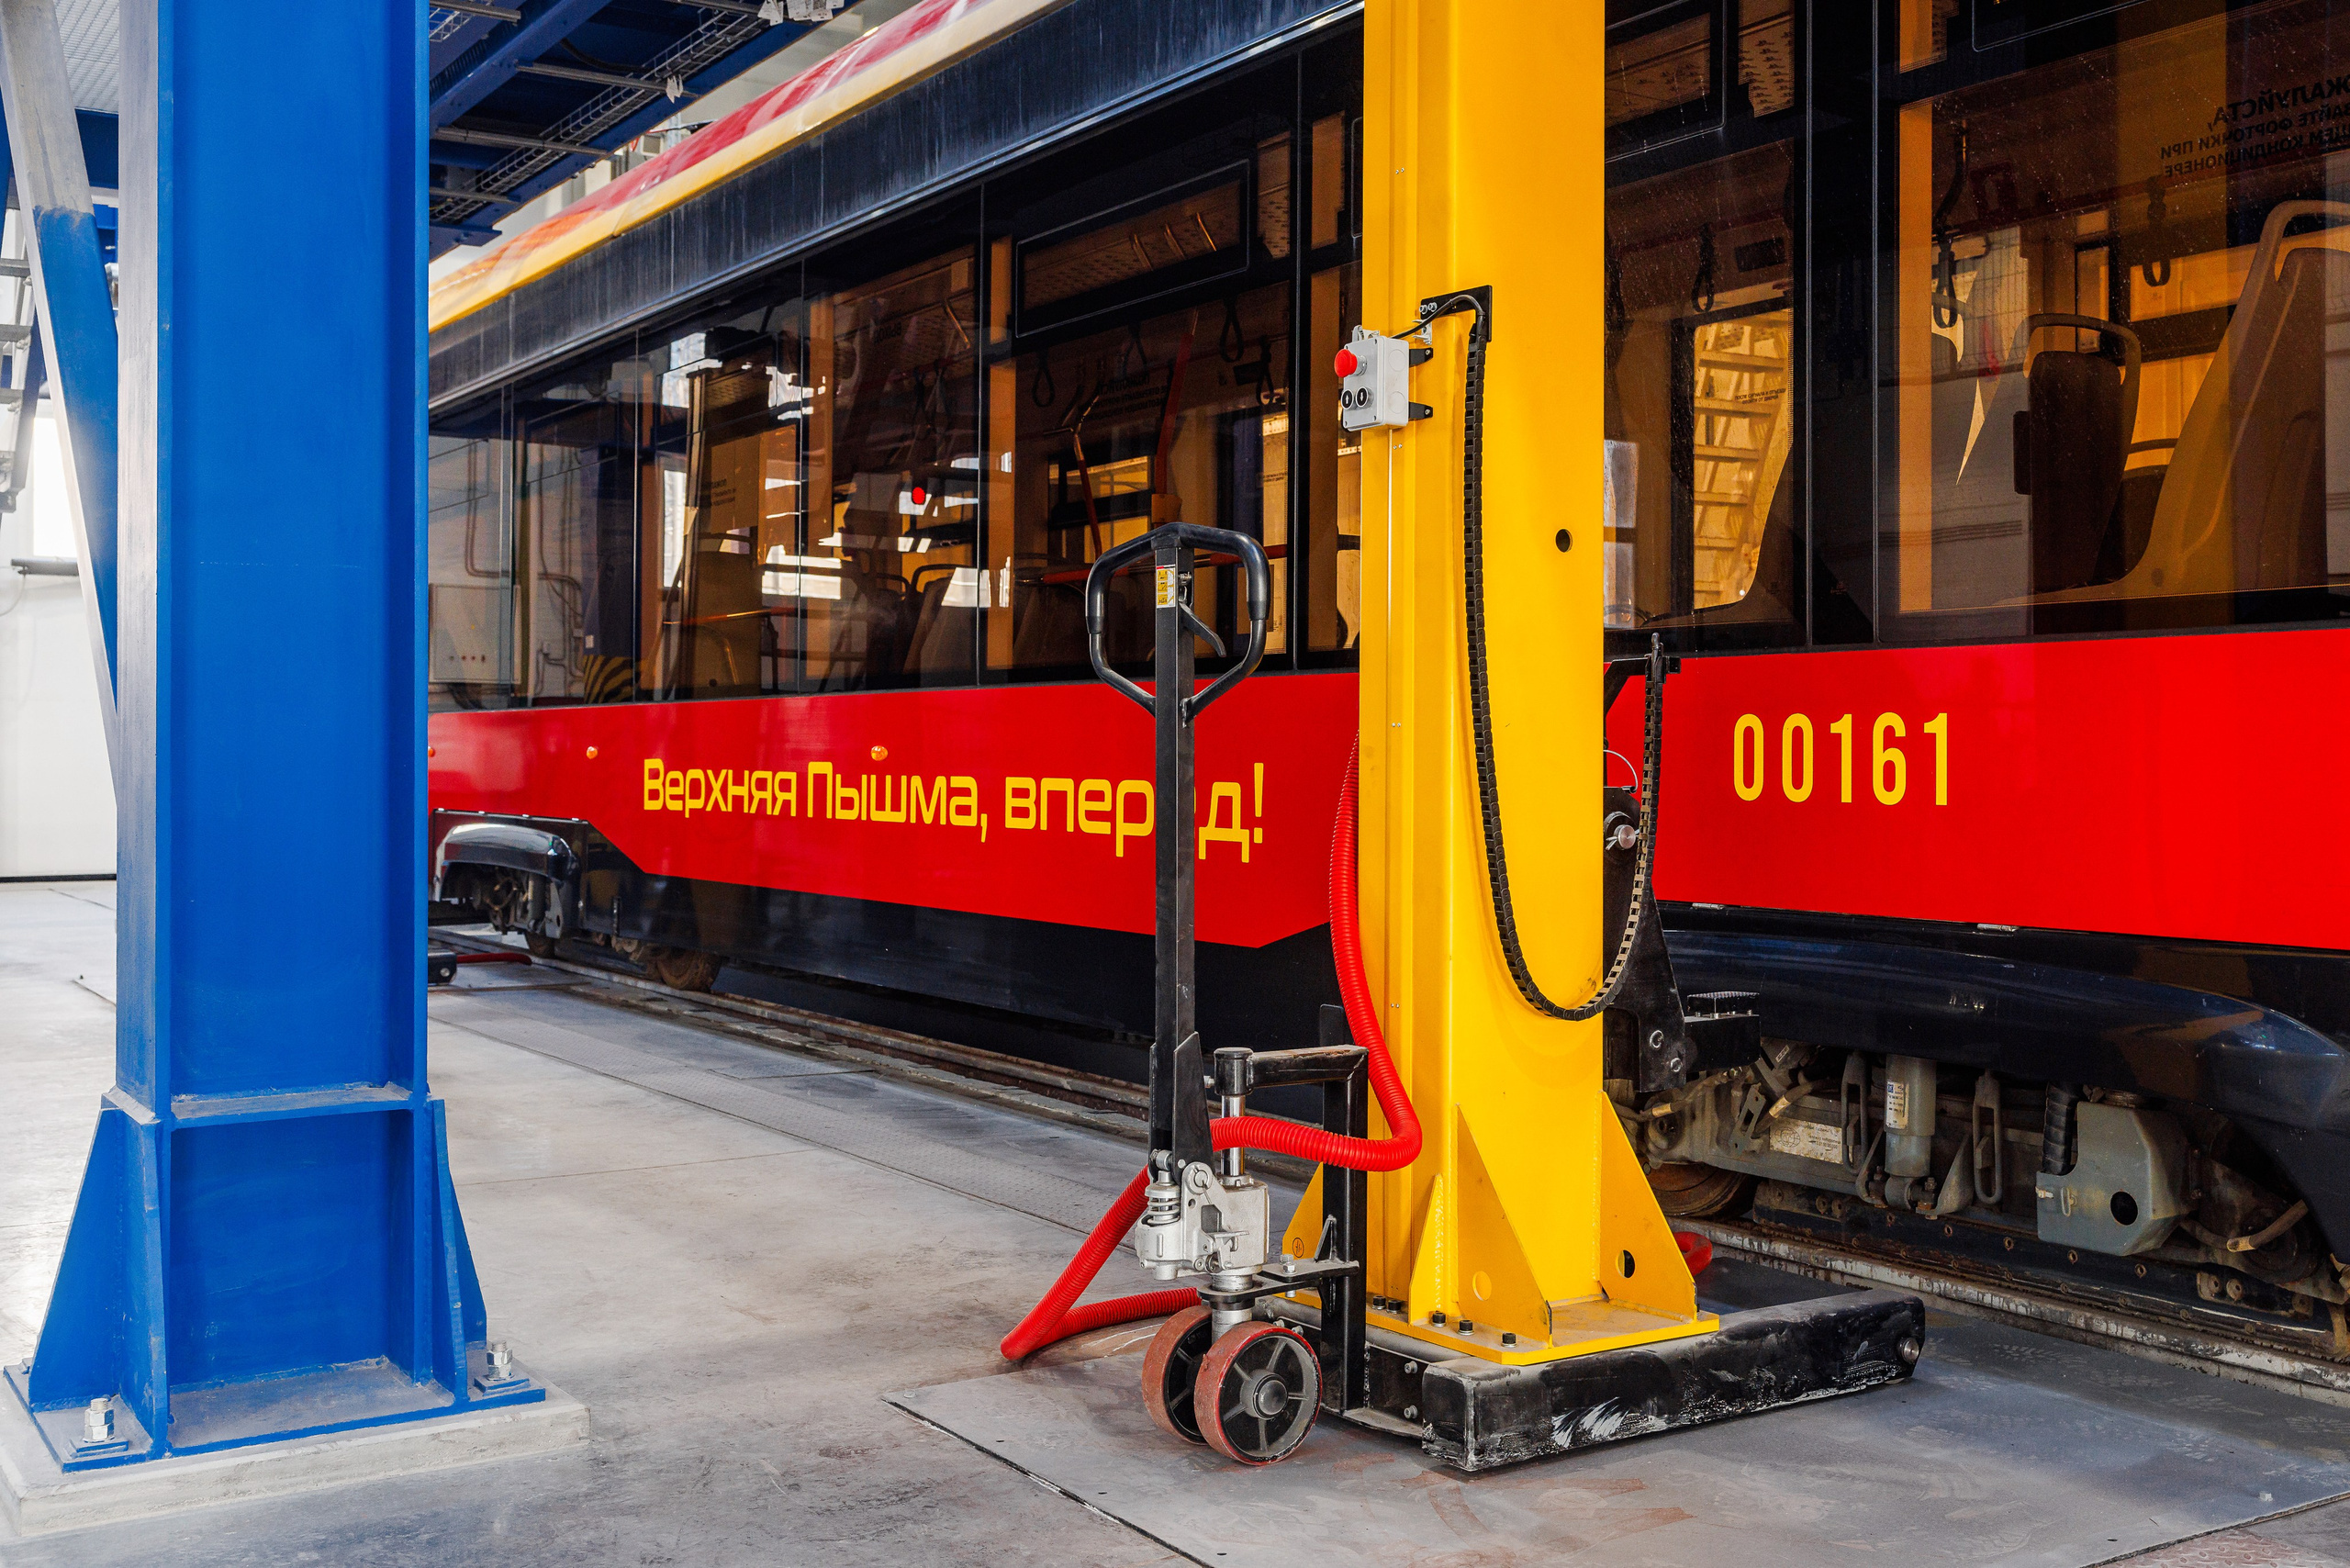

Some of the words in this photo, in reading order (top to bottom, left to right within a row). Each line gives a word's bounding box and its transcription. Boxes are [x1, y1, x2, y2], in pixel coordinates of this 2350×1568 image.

[1734, 712, 1947, 805] 00161
[644, 758, 796, 818] Верхняя
[808, 761, 987, 843] Пышма,
[1005, 763, 1263, 863] вперд!
